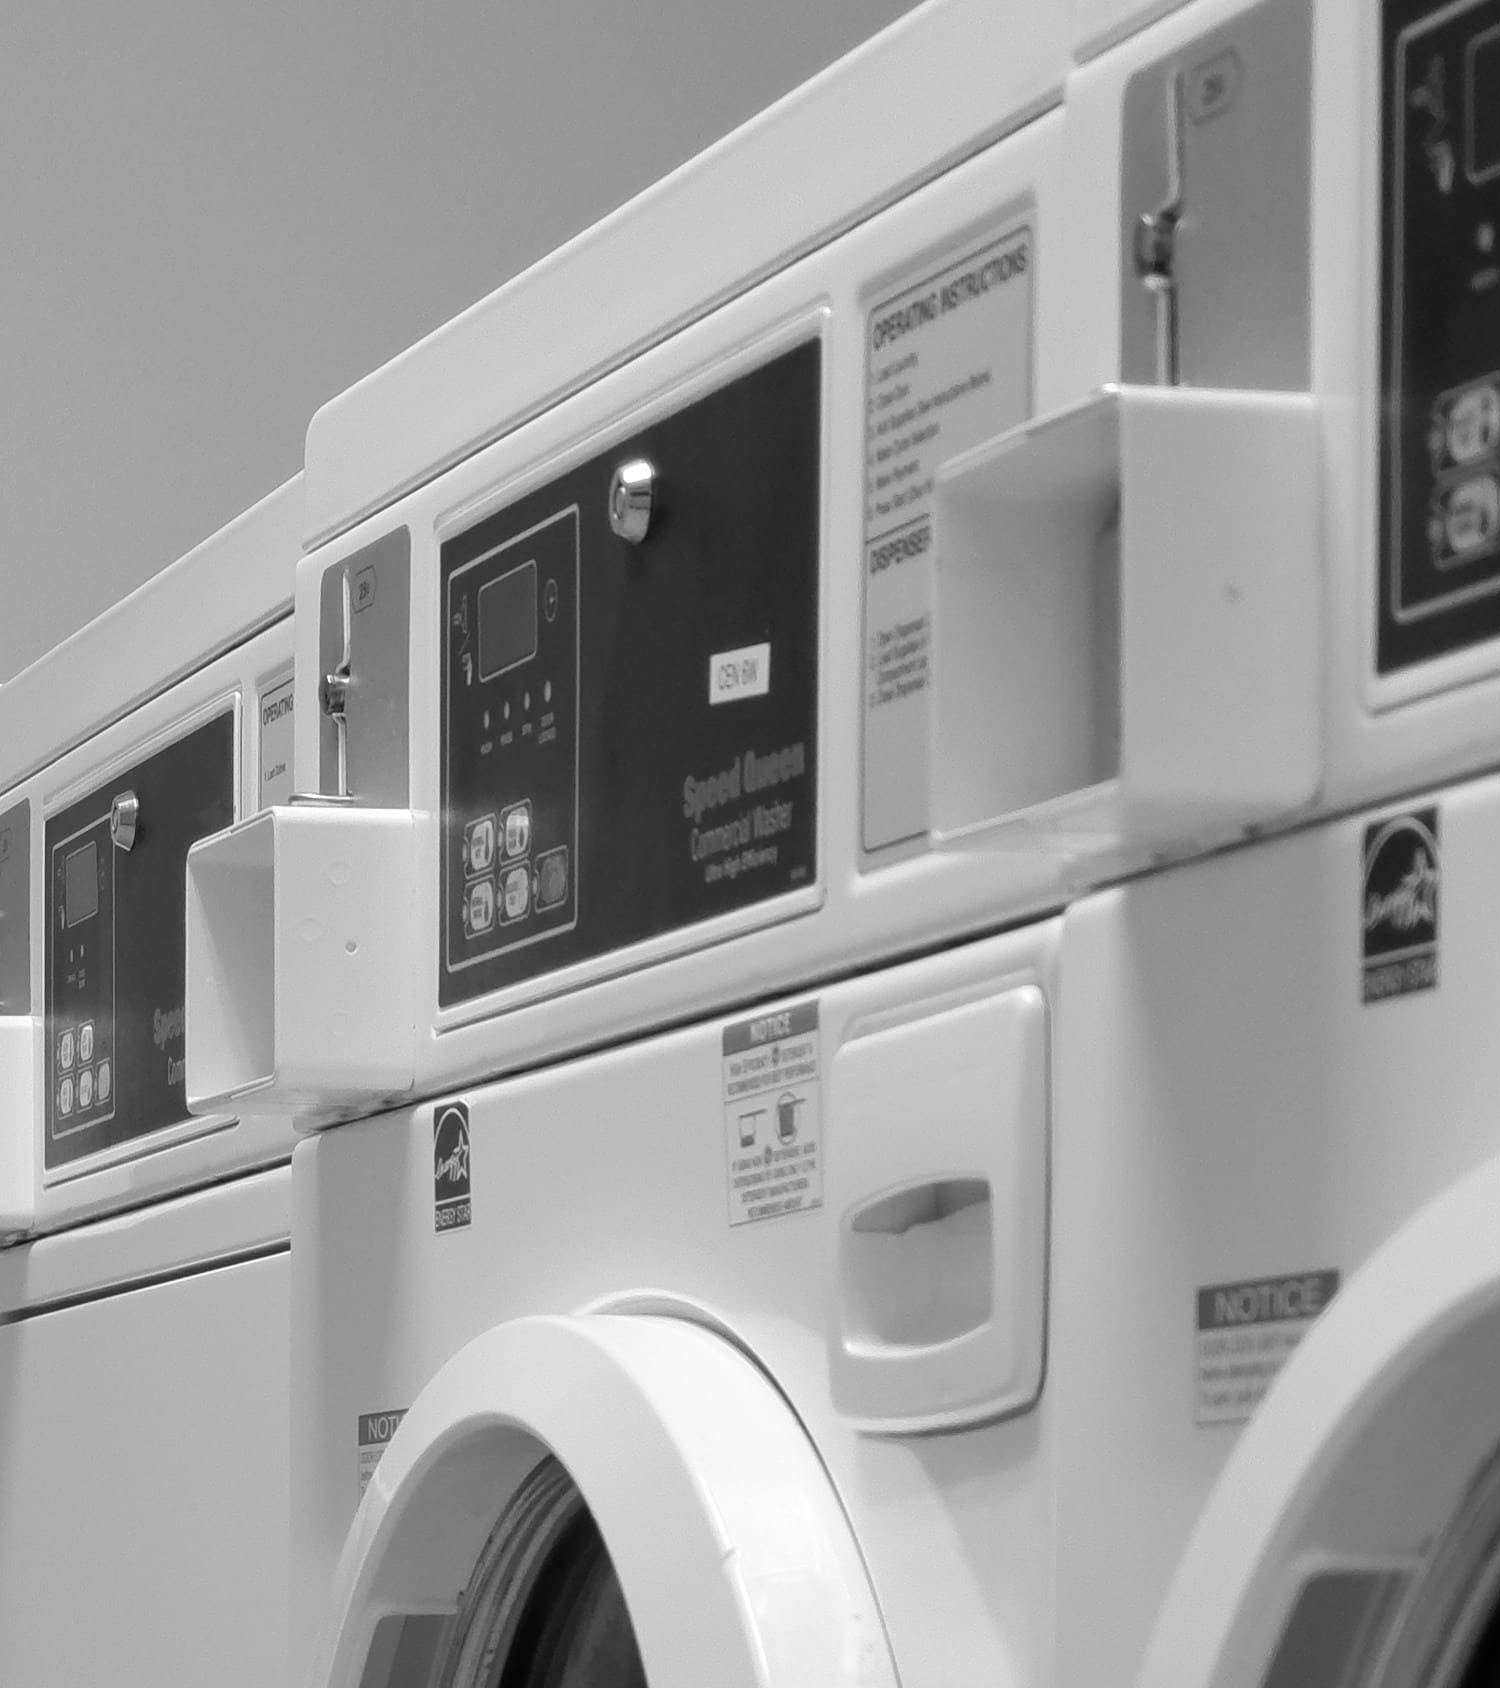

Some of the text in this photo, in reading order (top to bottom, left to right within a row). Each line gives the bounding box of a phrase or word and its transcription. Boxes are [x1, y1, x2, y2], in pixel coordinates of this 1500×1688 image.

[873, 243, 1028, 350] OPERATING INSTRUCTIONS
[262, 692, 294, 727] OPERATING
[682, 741, 805, 825] Speed Queen
[691, 800, 794, 862] Commercial Washer
[749, 1011, 793, 1044] NOTICE
[1213, 1277, 1325, 1322] NOTICE
[367, 1415, 401, 1441] NOTI
